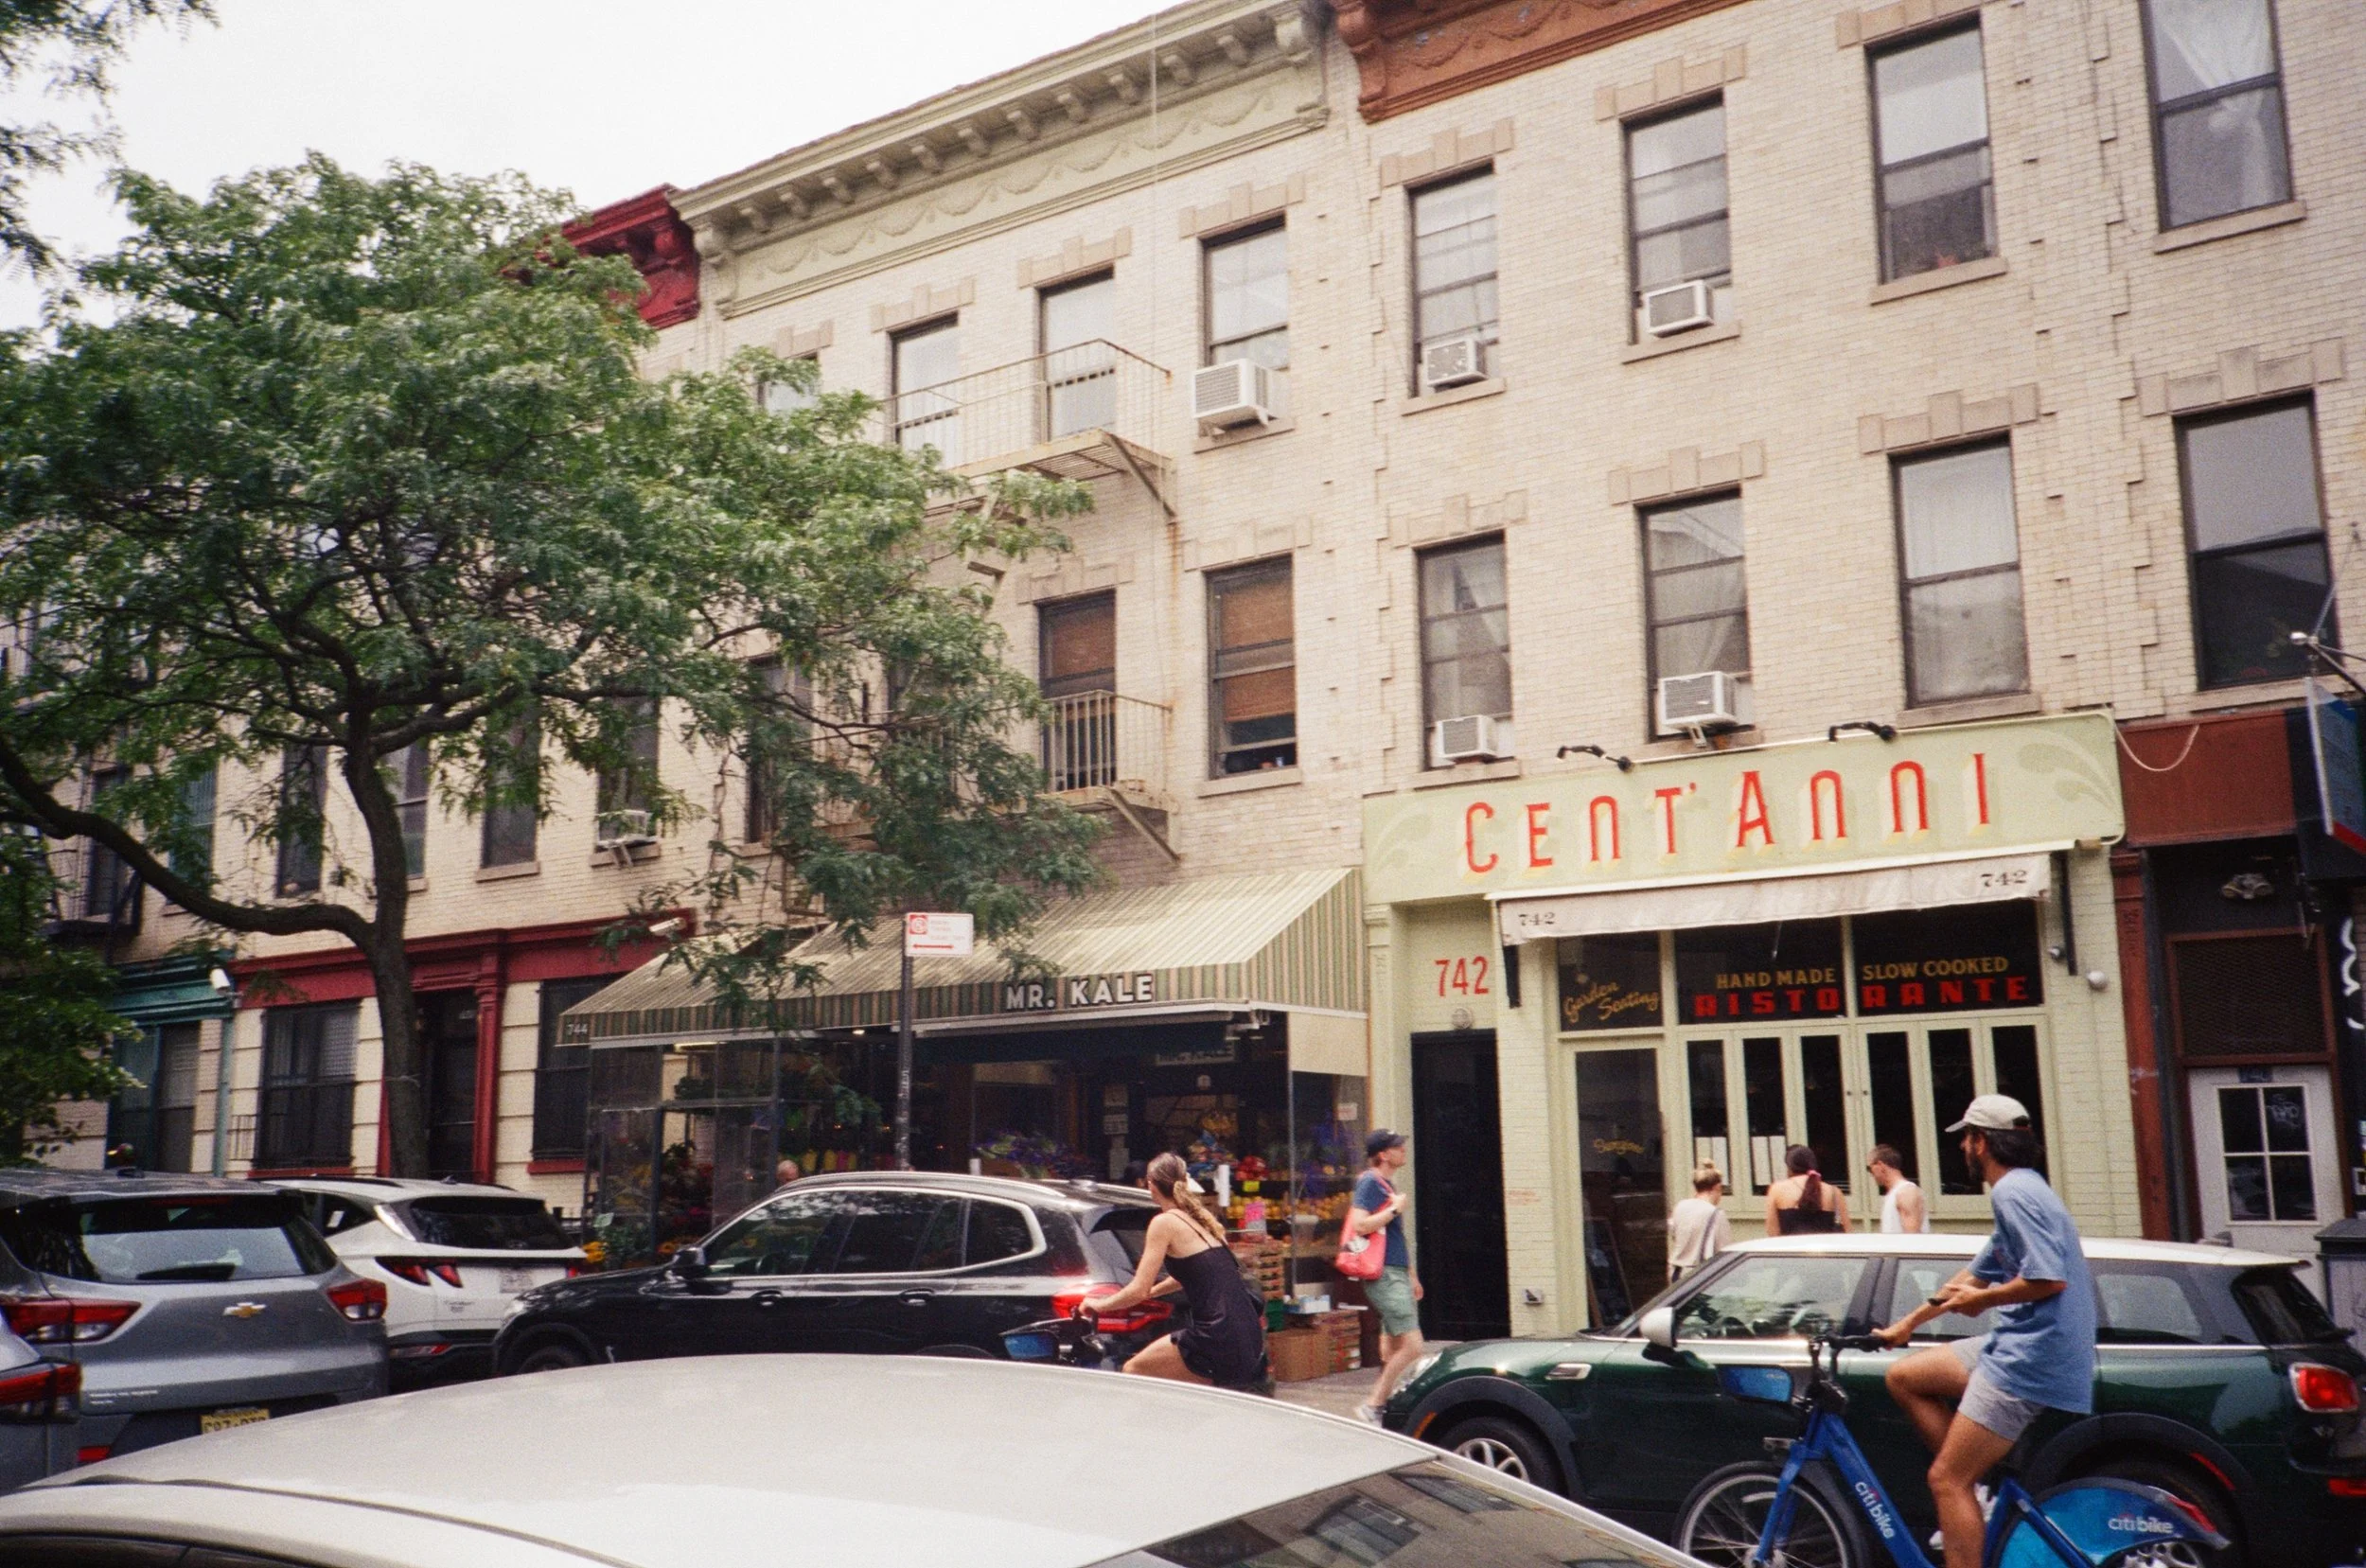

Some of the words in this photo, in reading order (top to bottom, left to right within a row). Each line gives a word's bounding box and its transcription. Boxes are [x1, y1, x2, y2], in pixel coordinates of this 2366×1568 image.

[1980, 870, 2028, 888] 742
[1519, 911, 1556, 926] 742
[1435, 956, 1490, 997] 742
[1716, 972, 1772, 990] HAND
[1776, 968, 1837, 987] MADE
[1863, 961, 1917, 981] SLOW
[1923, 956, 2009, 977] COOKED
[1006, 981, 1056, 1011] MR.
[1069, 974, 1154, 1007] KALE
[1563, 981, 1619, 1023] Garden
[1598, 991, 1659, 1020] Seating
